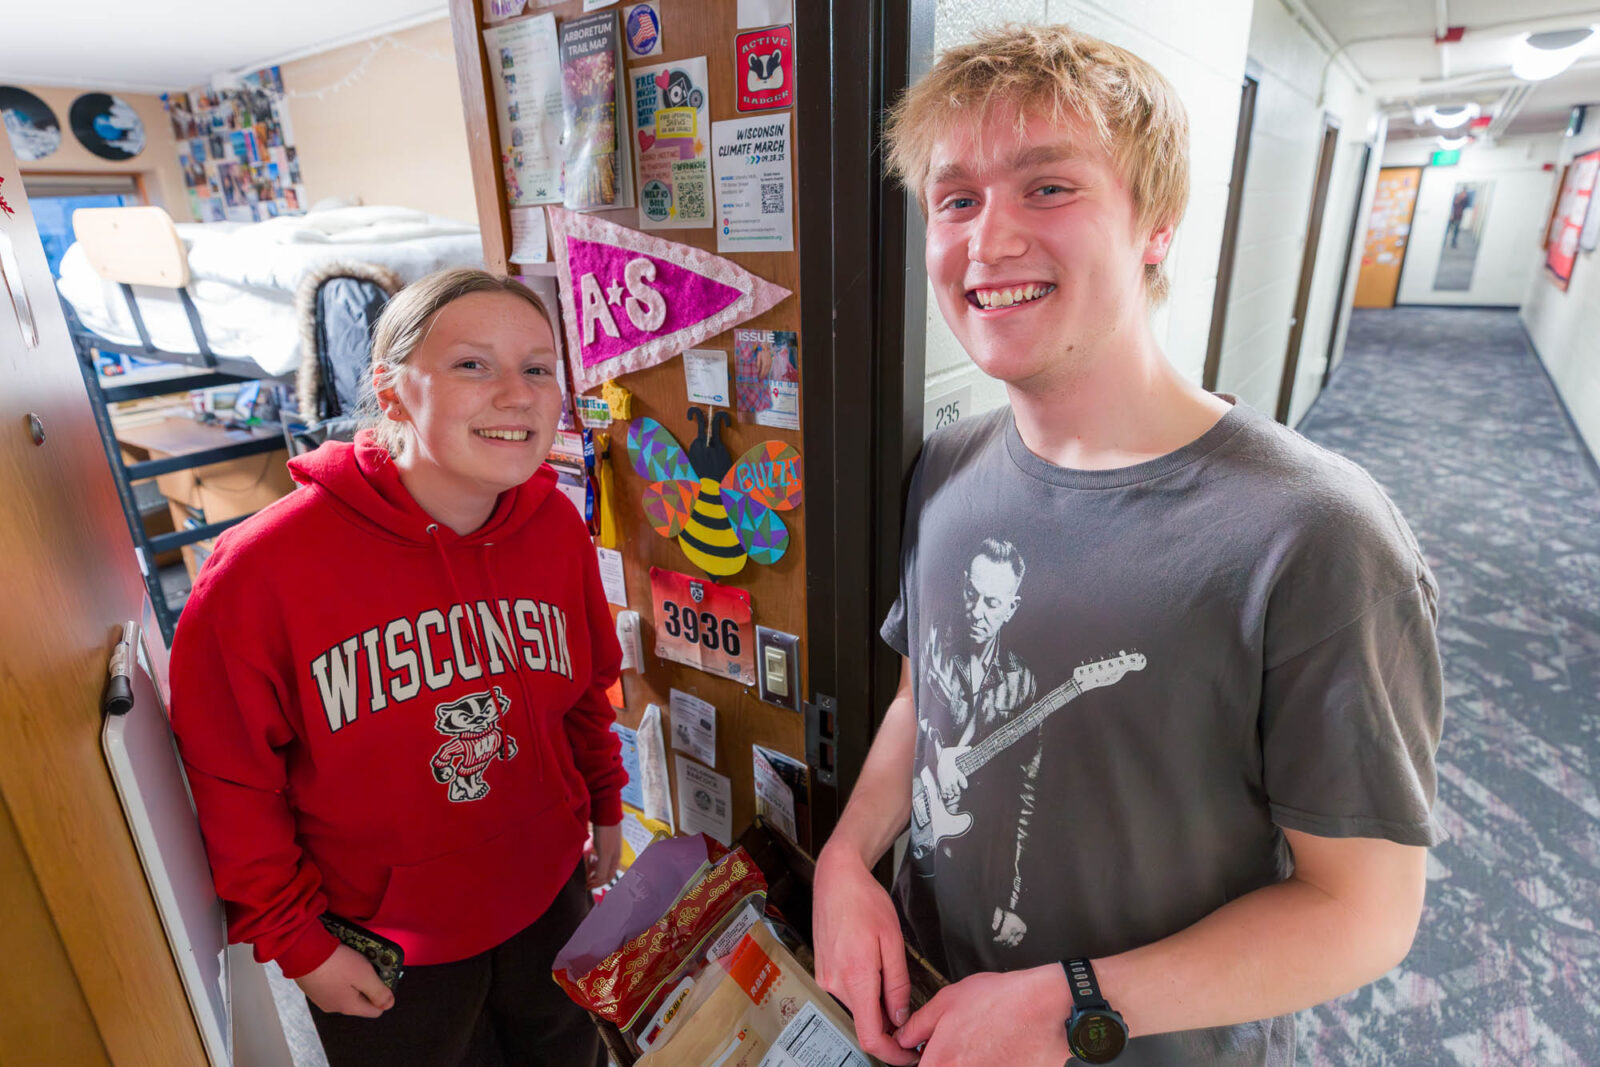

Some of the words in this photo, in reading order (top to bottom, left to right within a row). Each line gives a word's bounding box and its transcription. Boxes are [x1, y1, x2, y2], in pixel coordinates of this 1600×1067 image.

[564, 22, 612, 43] ARBORETUM
[568, 42, 589, 56] TRAIL
[589, 37, 608, 51] MAP
[742, 36, 788, 54] ACTIVE
[636, 73, 655, 88] FREE
[743, 90, 789, 105] BADGER
[737, 124, 785, 140] WISCONSIN
[719, 143, 753, 157] CLIMATE
[753, 139, 785, 153] MARCH
[761, 153, 785, 162] 09.28.25
[644, 190, 660, 198] HELP
[739, 331, 775, 344] ISSUE
[936, 400, 960, 430] 235
[736, 460, 798, 493] BUZZ!
[663, 600, 741, 656] 3936
[311, 599, 574, 734] WISCONSIN
